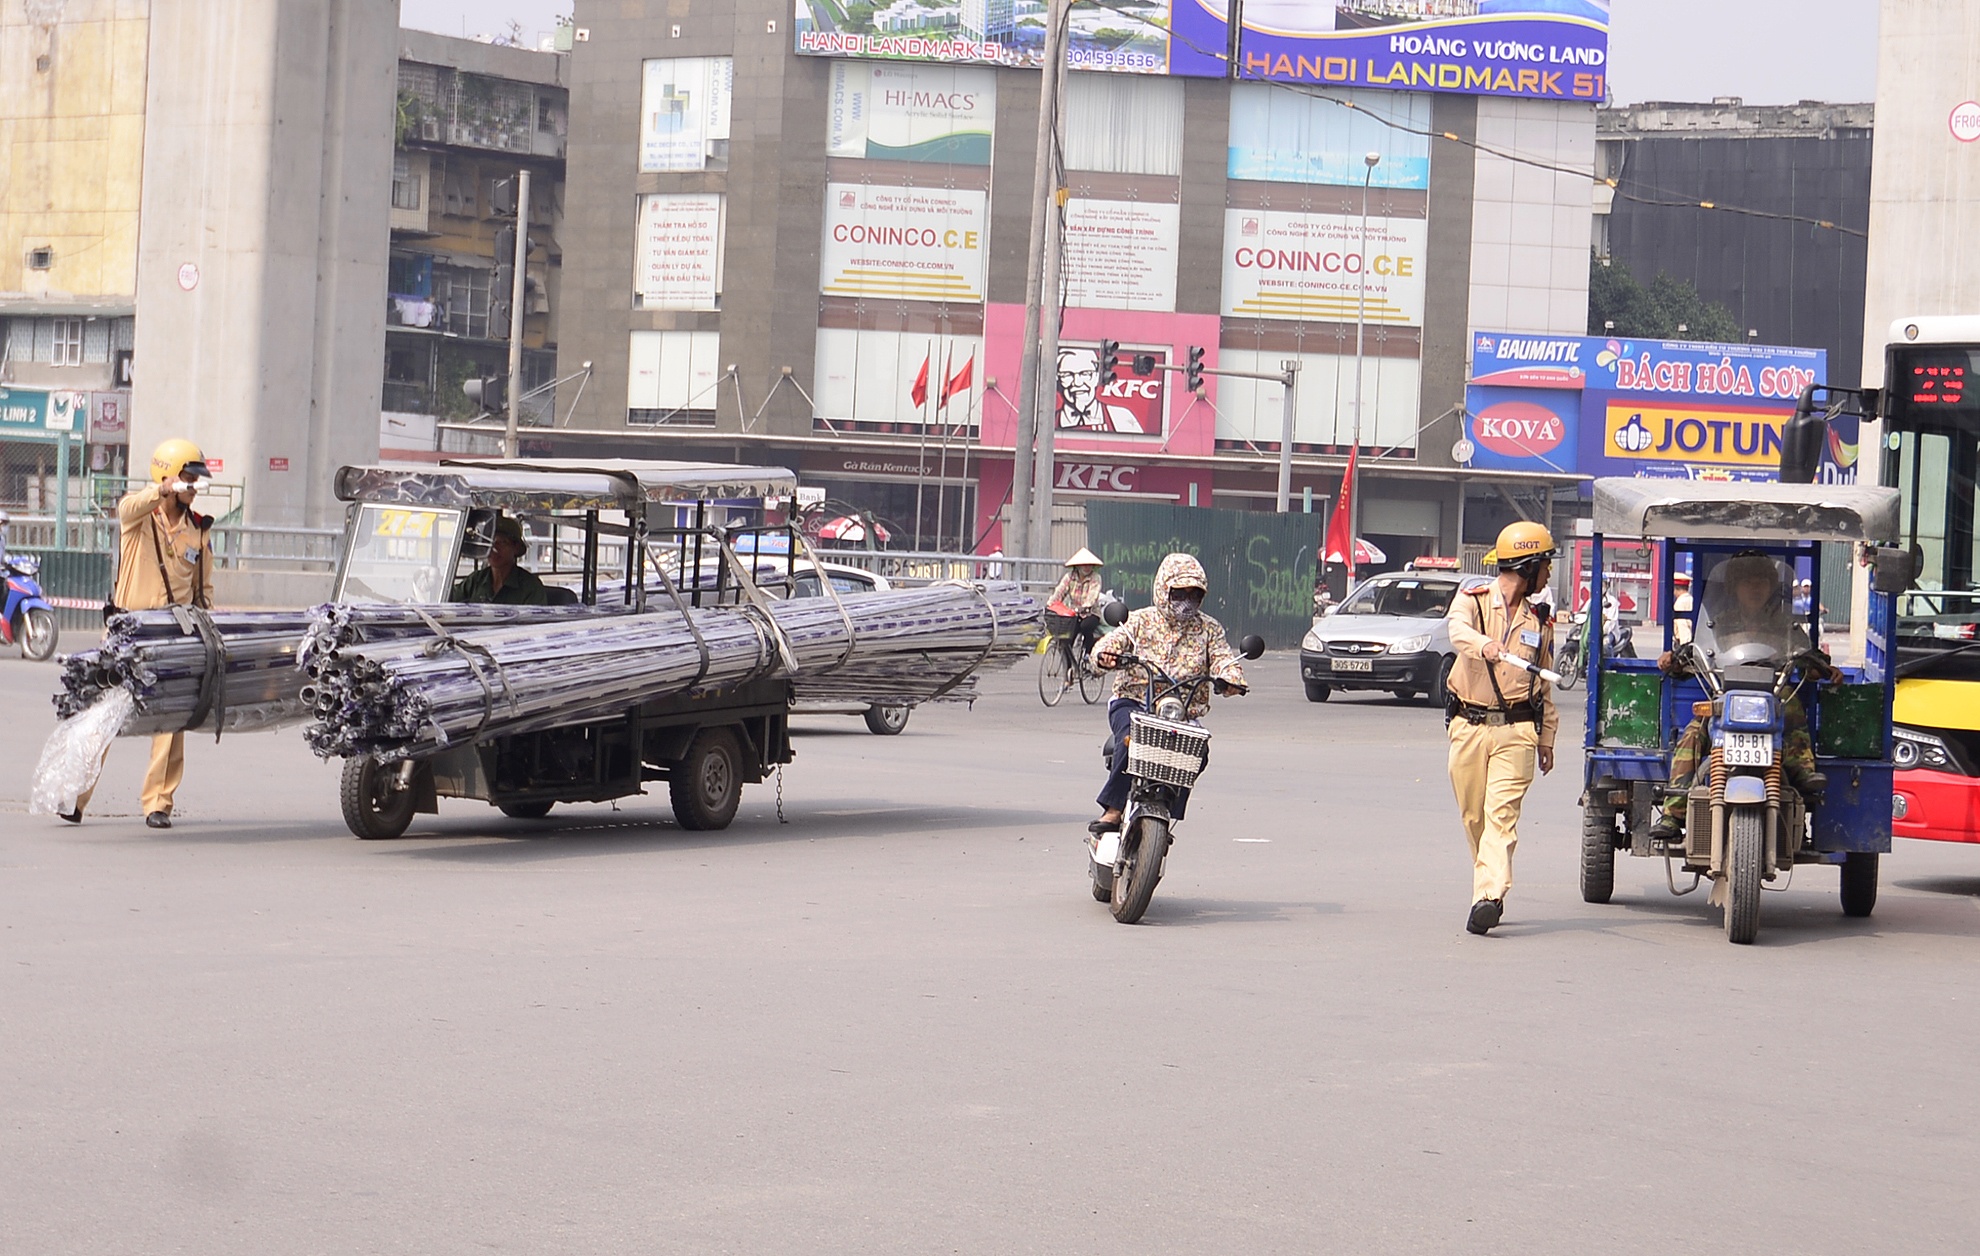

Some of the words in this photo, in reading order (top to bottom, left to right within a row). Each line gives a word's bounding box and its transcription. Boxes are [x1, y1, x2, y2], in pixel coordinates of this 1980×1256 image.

[802, 33, 864, 53] HANOI
[869, 36, 978, 58] LANDMARK
[983, 44, 1002, 59] 51
[1390, 35, 1466, 58] HOÀNG
[1473, 40, 1545, 62] VƯƠNG
[1550, 46, 1604, 66] LAND
[1246, 52, 1357, 81] HANOI
[1367, 59, 1563, 95] LANDMARK
[1573, 70, 1604, 97] 51
[886, 89, 975, 110] HI-MACS
[1496, 339, 1581, 362] BAUMATIC
[1617, 352, 1692, 391] BÁCH
[1696, 357, 1754, 396] HÓA
[1759, 365, 1815, 398] SƠN
[1101, 380, 1160, 399] KFC
[4, 407, 28, 422] LINH
[29, 408, 37, 423] 2
[1481, 418, 1557, 440] KOVA
[1656, 418, 1785, 455] JOTUN
[843, 461, 858, 470] Gà
[859, 462, 882, 471] Rán
[1056, 463, 1136, 491] KFC
[1823, 462, 1858, 485] Dul
[800, 493, 821, 501] Bank
[377, 509, 438, 538] 27-7
[1513, 541, 1540, 550] CSGT
[1732, 734, 1765, 748] 18-B1
[1726, 749, 1768, 764] 533.91
